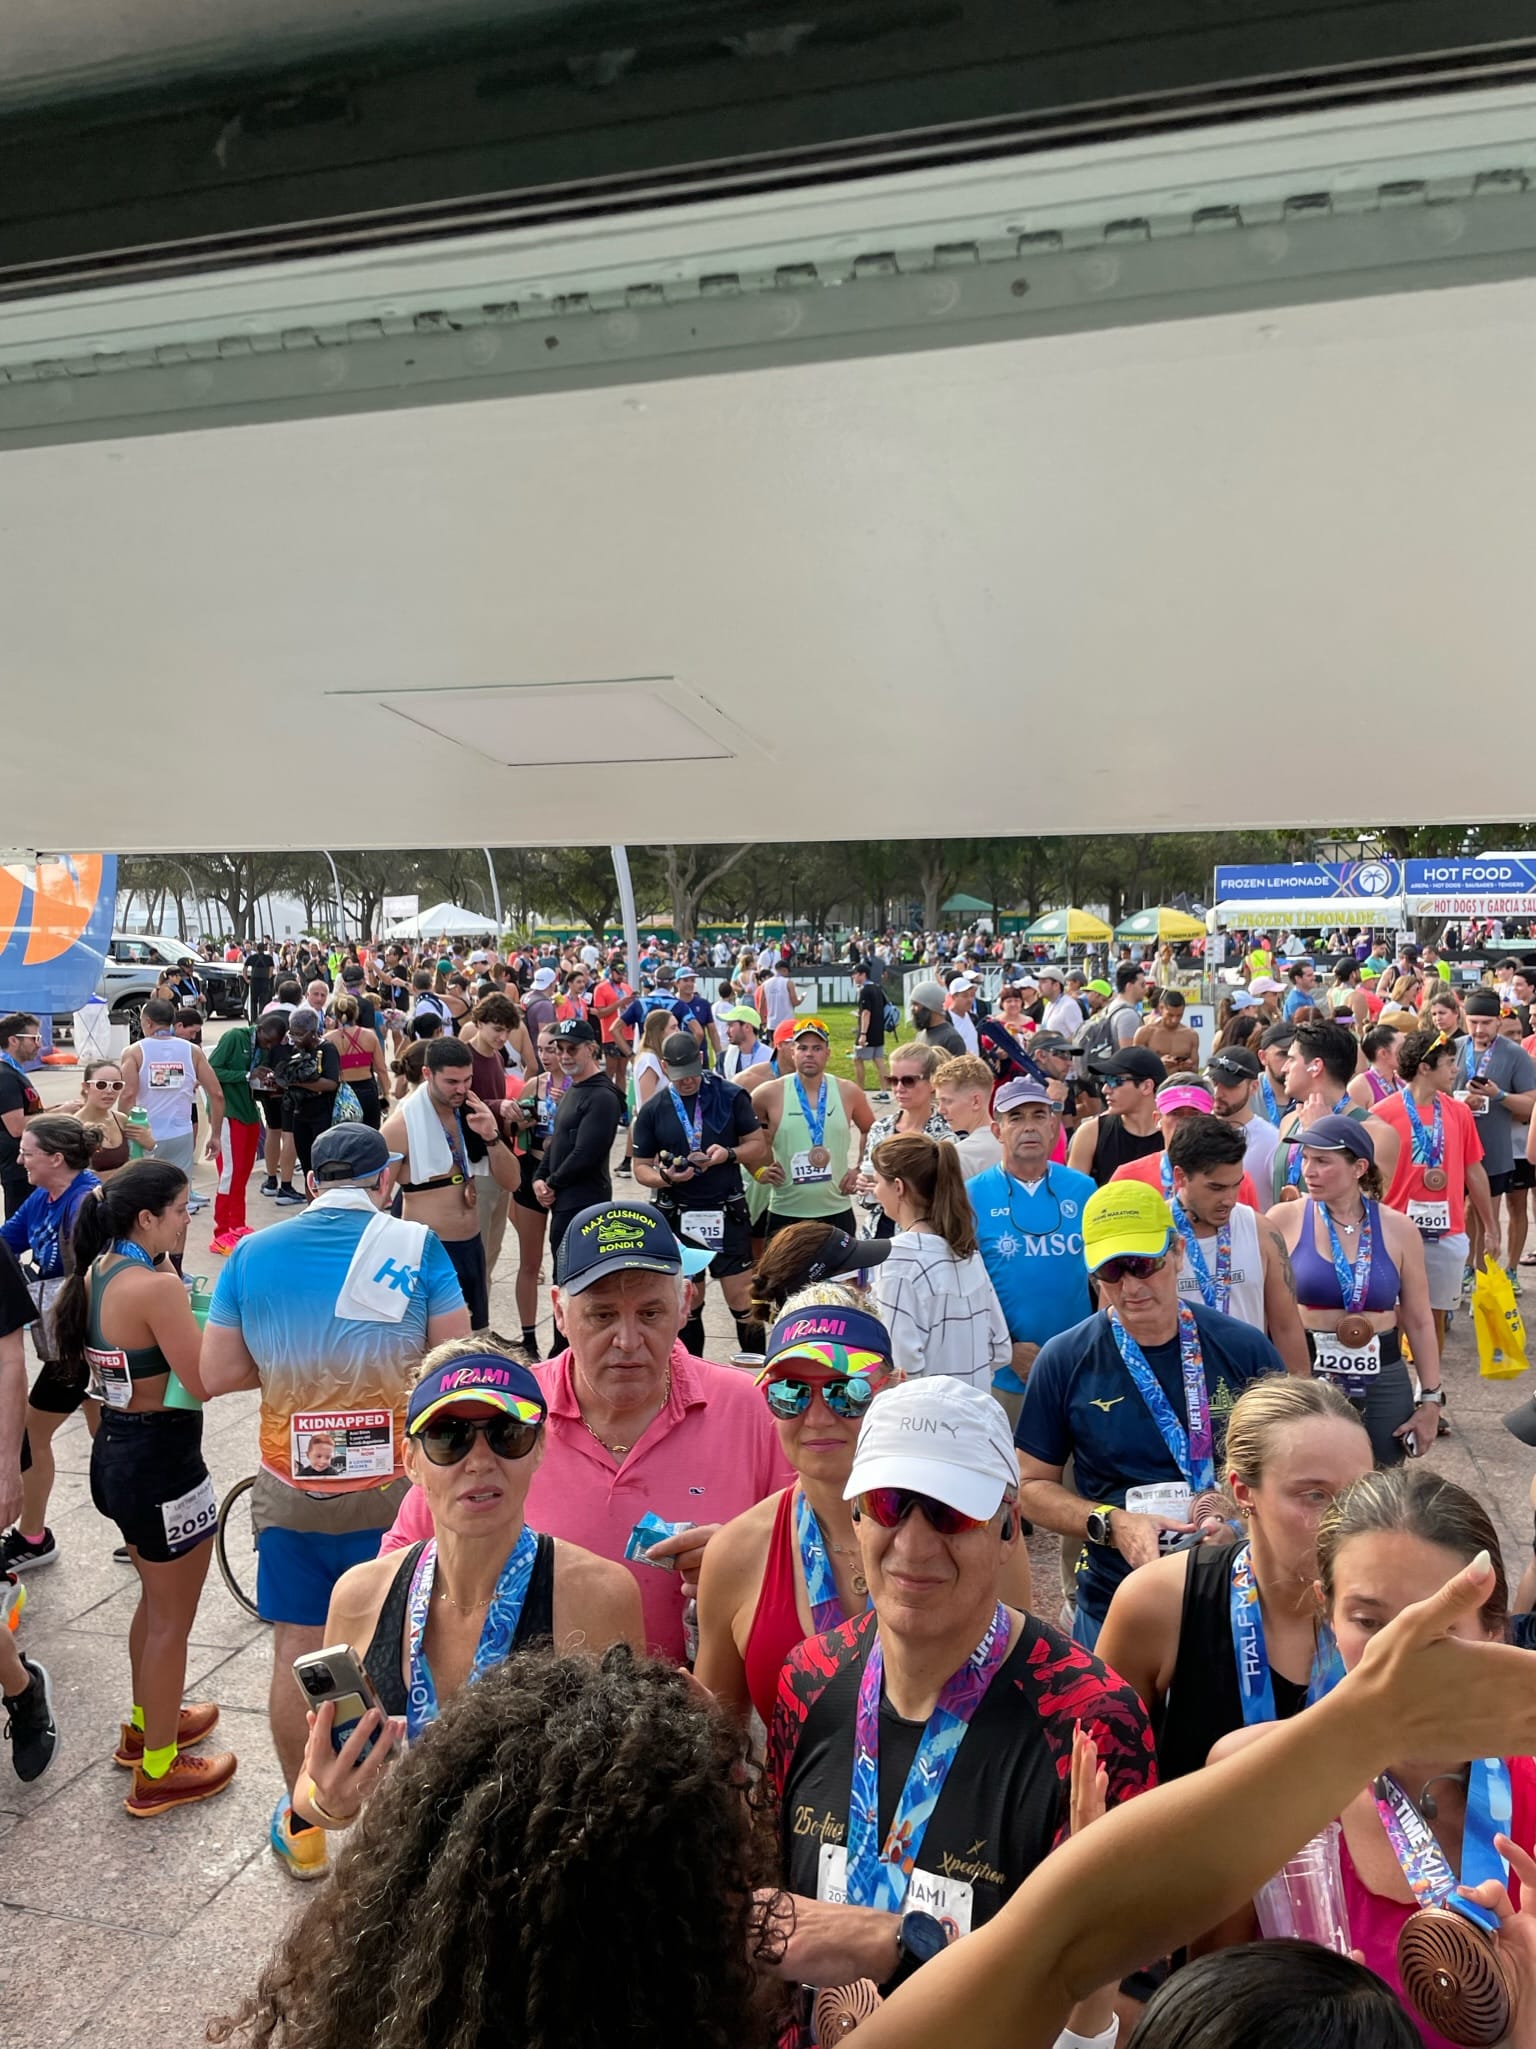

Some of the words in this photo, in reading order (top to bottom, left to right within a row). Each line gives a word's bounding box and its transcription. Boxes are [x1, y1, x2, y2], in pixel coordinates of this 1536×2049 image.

[1221, 878, 1265, 889] FROZEN
[1267, 876, 1329, 888] LEMONADE
[1424, 868, 1459, 881] HOT
[1462, 867, 1512, 881] FOOD
[1434, 900, 1451, 913] HOT
[1454, 900, 1476, 913] DOGS
[1480, 900, 1485, 913] Y
[1488, 899, 1519, 913] GARCIA
[1237, 913, 1294, 927] FROZEN
[1296, 911, 1375, 926] LEMONADE
[818, 976, 858, 1003] TIM
[581, 1215, 605, 1236] MAX
[607, 1210, 657, 1229] CUSHION
[600, 1241, 635, 1253] BONDI
[637, 1241, 644, 1249] 9
[1023, 1233, 1082, 1256] MSC
[1182, 1341, 1197, 1384] MIAMI
[1320, 1354, 1378, 1371] 12068
[1187, 1387, 1200, 1411] TIME
[298, 1414, 385, 1430] KIDNAPPED
[900, 1417, 937, 1434] RUN
[1190, 1410, 1202, 1431] LIFE
[970, 1632, 995, 1666] LIFE
[1238, 1614, 1261, 1676] HALF
[793, 1805, 813, 1836] 25
[1395, 1799, 1430, 1847] TIME
[936, 1850, 1007, 1885] Xpedition
[910, 1880, 946, 1908] IAMI
